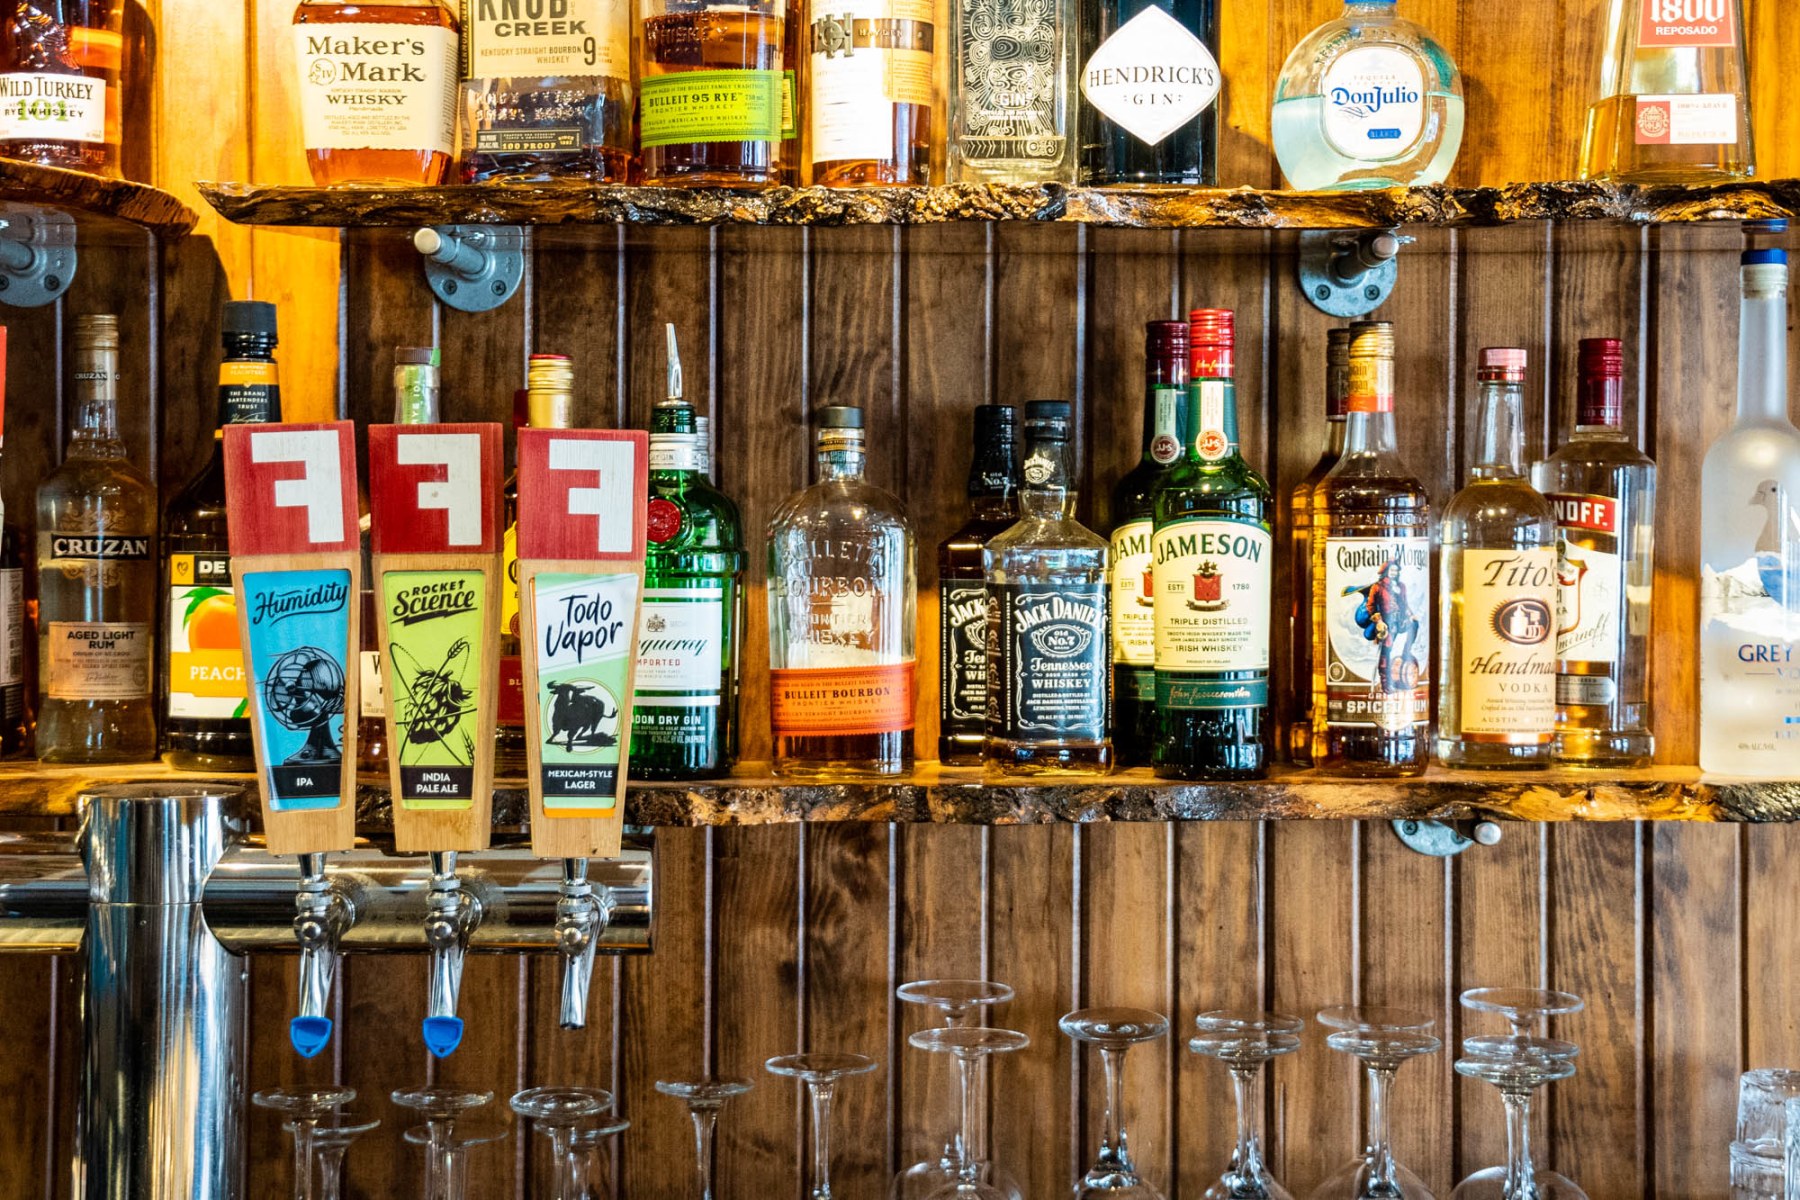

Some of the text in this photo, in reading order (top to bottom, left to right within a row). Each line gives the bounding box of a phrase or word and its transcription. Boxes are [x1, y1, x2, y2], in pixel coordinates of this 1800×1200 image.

[1649, 0, 1726, 23] 1800
[495, 20, 587, 37] CREEK
[1655, 26, 1718, 36] REPOSADO
[306, 35, 425, 57] Maker's
[549, 46, 582, 55] BOURBON
[583, 36, 596, 66] 9
[340, 62, 424, 82] Mark
[1089, 65, 1214, 88] HENDRICK'S
[0, 76, 94, 100] WILD TURKEY
[326, 94, 408, 105] WHISKY
[649, 91, 738, 108] BULLEIT 95 RYE
[1000, 93, 1026, 107] GIN
[1132, 93, 1173, 105] GIN
[5, 108, 85, 118] RYE WHISKEY
[17, 99, 69, 122] 101
[502, 142, 557, 151] 100 PROOF
[54, 537, 148, 556] CRUZAN
[1157, 533, 1262, 565] JAMESON
[1337, 544, 1389, 572] Captain
[198, 560, 226, 574] DE
[1482, 555, 1557, 587] Tito's
[411, 579, 466, 597] ROCKET
[252, 581, 349, 626] Humidity
[392, 589, 475, 618] Science
[559, 592, 613, 628] Todo
[949, 597, 988, 627] JACK
[1014, 602, 1053, 633] JACK
[1169, 617, 1249, 626] TRIPLE DISTILLED
[66, 631, 136, 641] AGED LIGHT
[546, 620, 624, 665] Vapor
[88, 641, 116, 650] RUM
[1175, 643, 1243, 653] IRISH WHISKEY
[1737, 643, 1794, 663] GREY
[1030, 657, 1093, 672] Tennessee
[1031, 678, 1092, 689] WHISKEY
[1499, 682, 1549, 693] VODKA
[784, 686, 891, 700] BULLEIT BOURBON
[658, 715, 702, 725] DRY GIN
[422, 772, 451, 783] INDIA
[547, 769, 613, 779] MEXICAN-STYLE
[296, 777, 314, 788] IPA
[416, 783, 459, 794] PALE ALE
[564, 780, 597, 790] LAGER
